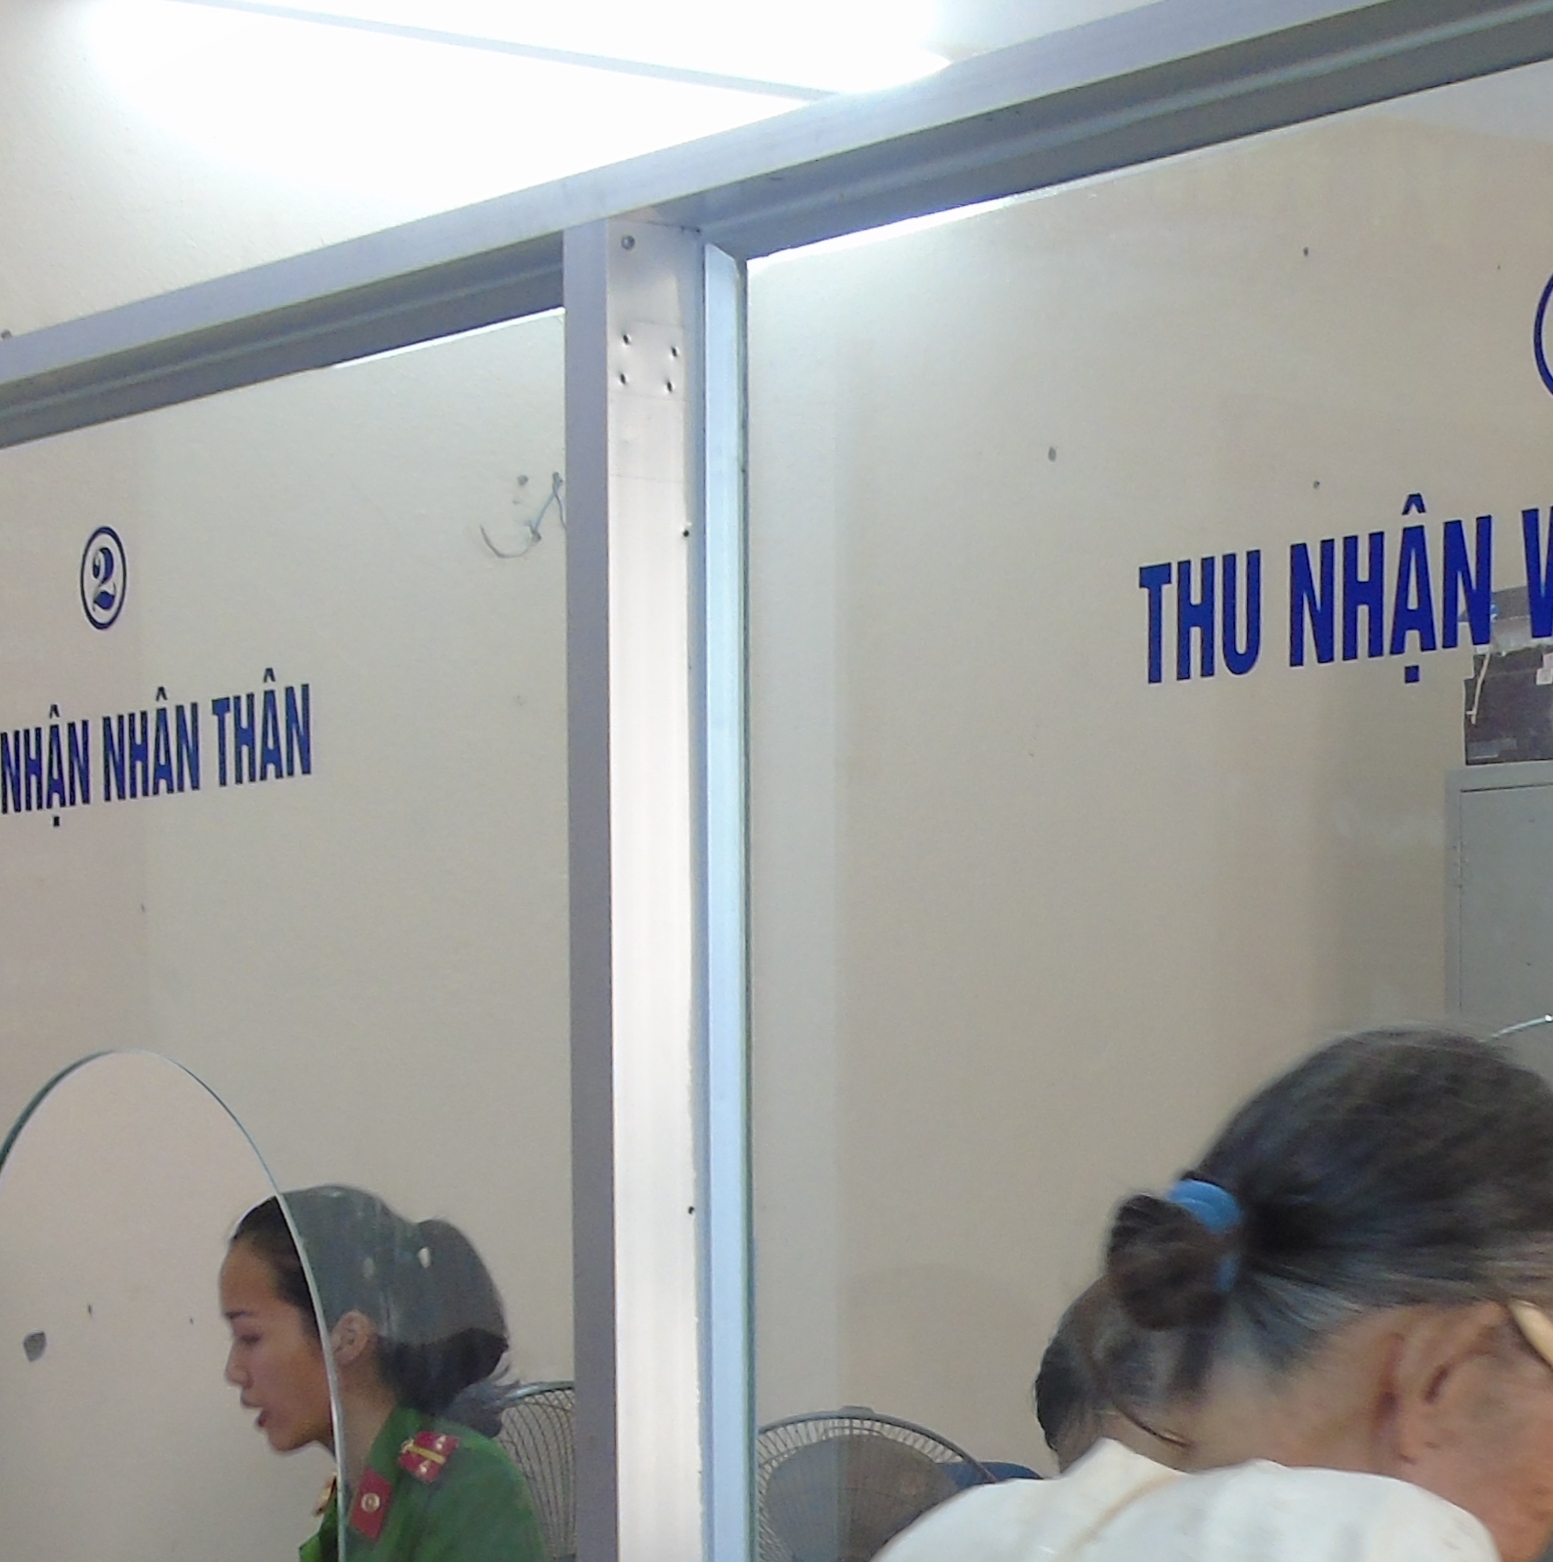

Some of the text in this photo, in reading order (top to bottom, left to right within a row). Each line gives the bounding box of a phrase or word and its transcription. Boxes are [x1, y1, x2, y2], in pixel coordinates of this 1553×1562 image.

[1139, 549, 1261, 684] THU
[1289, 493, 1492, 684] NHẬN
[0, 704, 90, 827] NHẬN
[103, 687, 200, 802] NHÂN
[212, 667, 312, 787] THÂN
